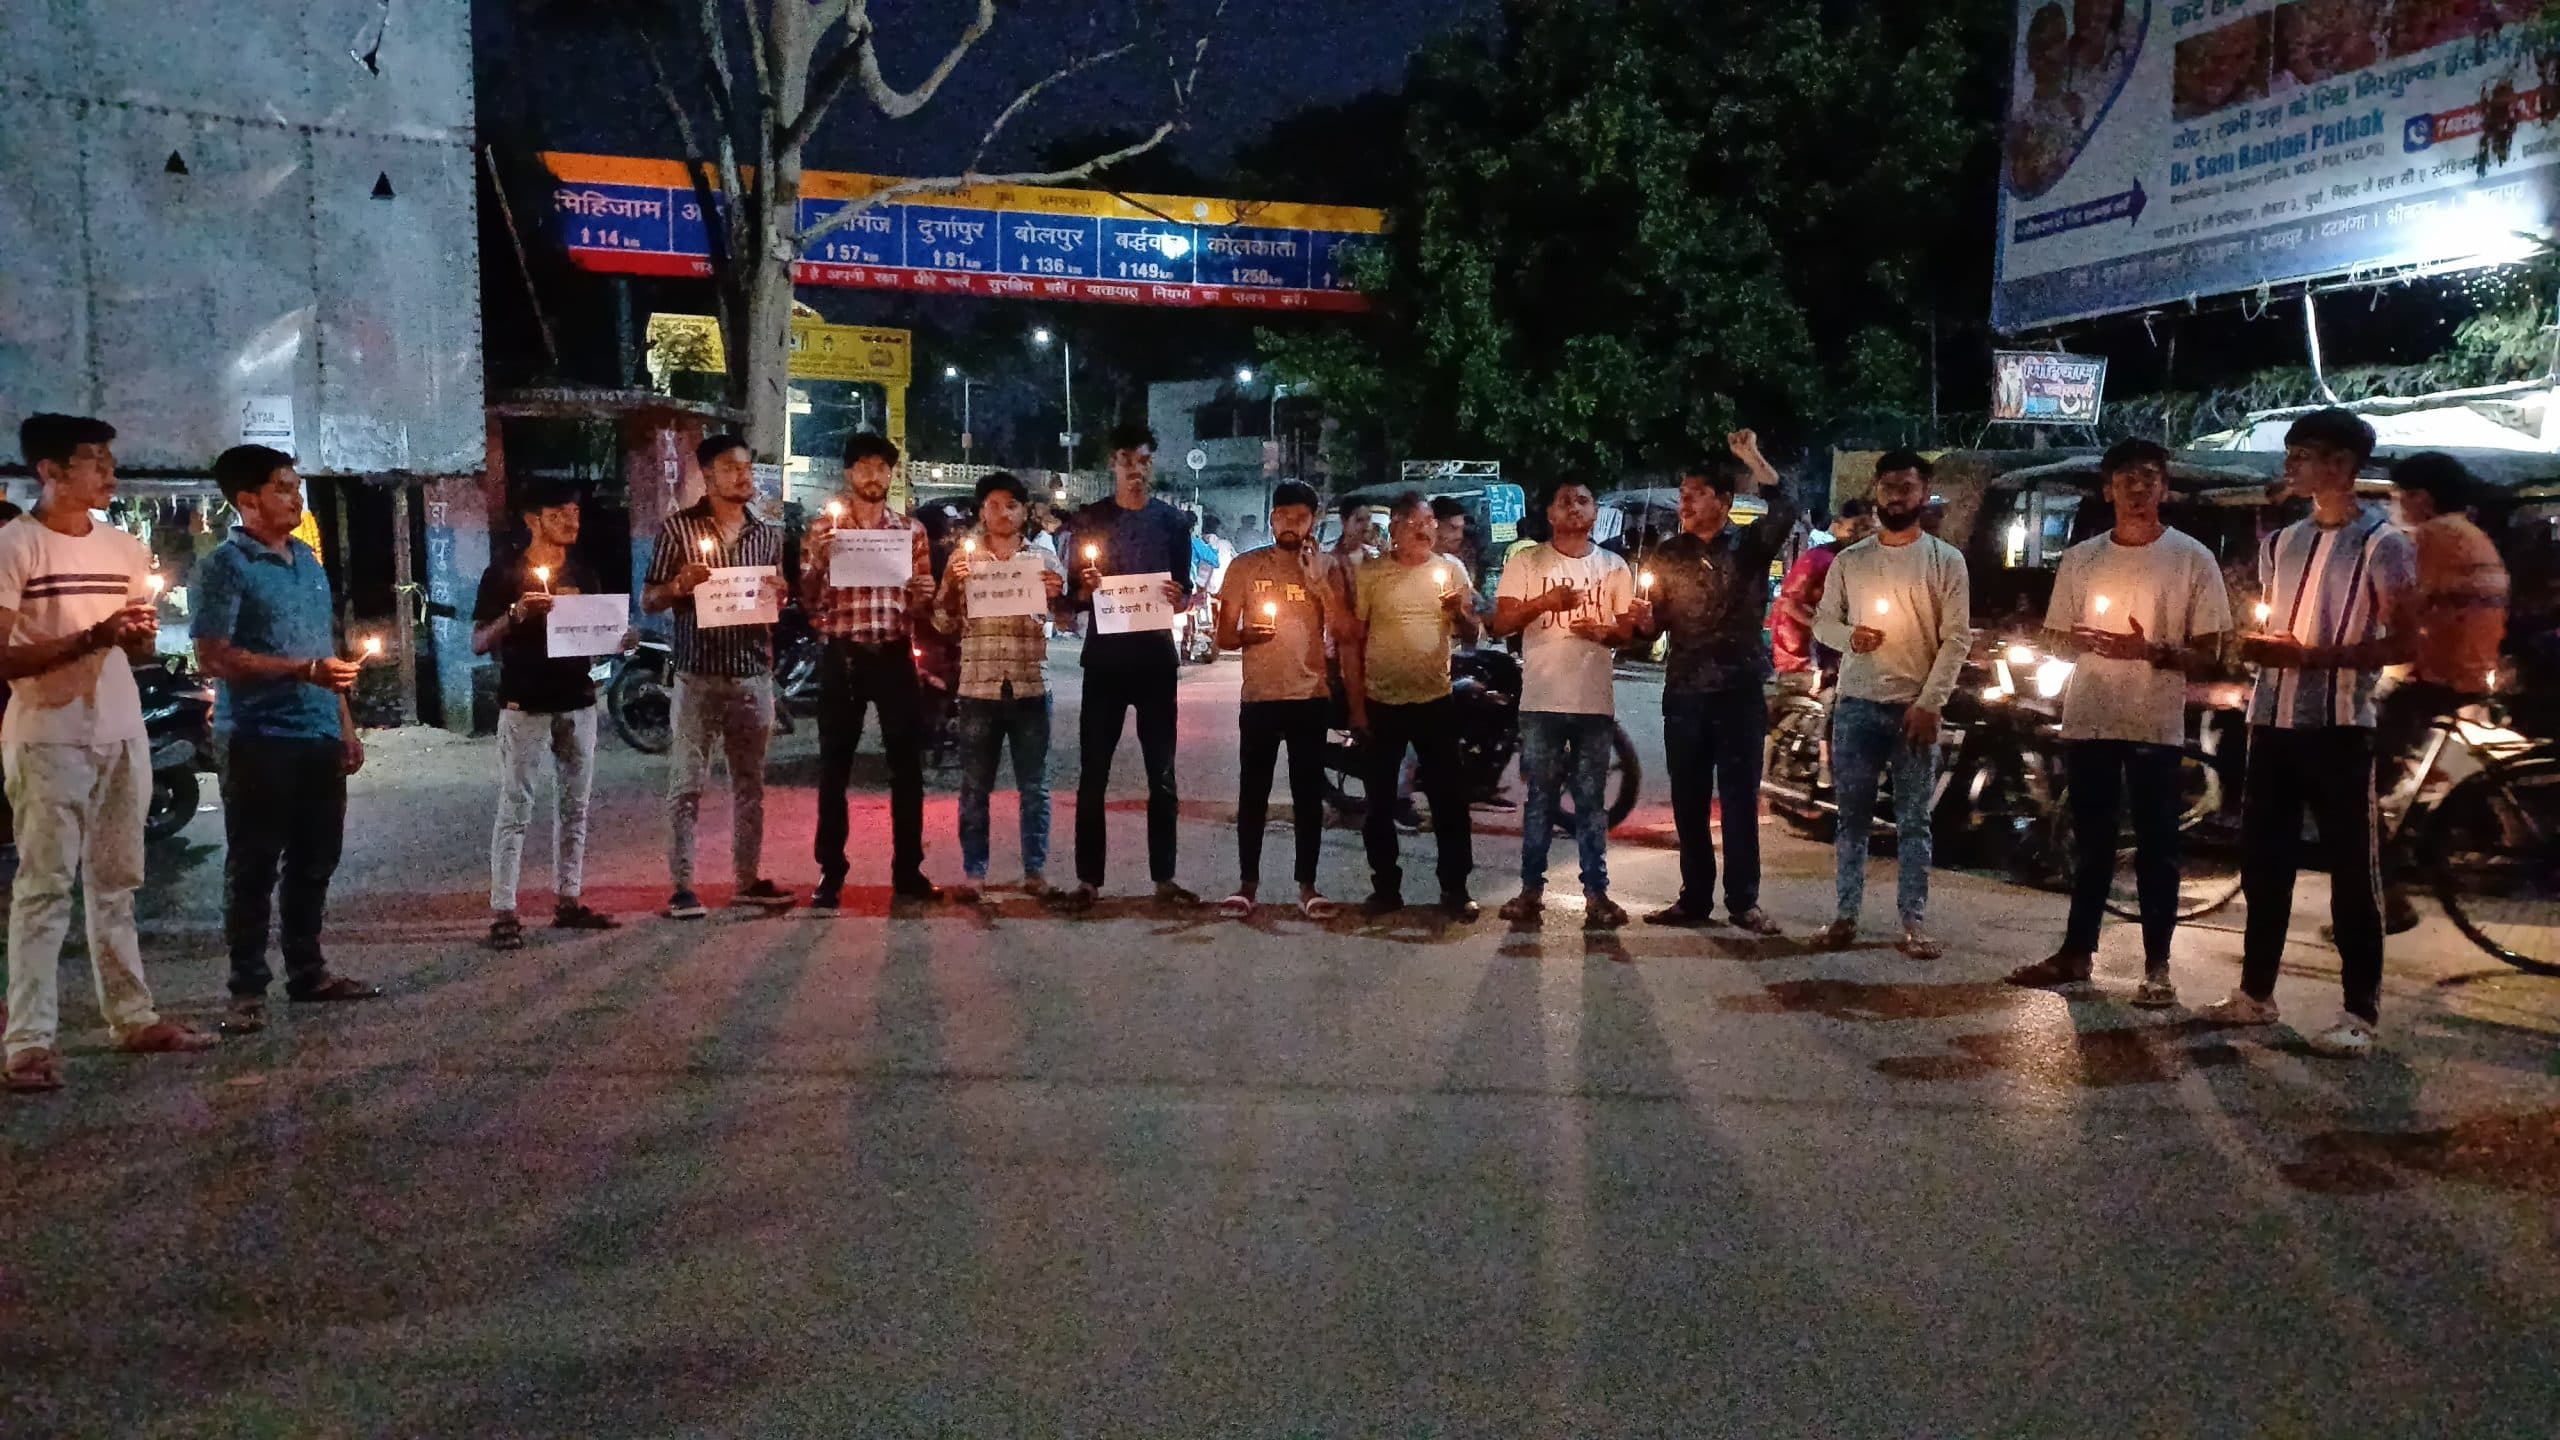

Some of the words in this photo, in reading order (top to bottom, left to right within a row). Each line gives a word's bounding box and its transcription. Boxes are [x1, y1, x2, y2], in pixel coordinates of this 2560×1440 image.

[2170, 161, 2191, 187] Dr.
[2312, 106, 2385, 150] Pathak
[597, 230, 619, 246] 14
[917, 215, 985, 246] दुर्गापुर
[1012, 220, 1085, 252] बोलपुर
[840, 245, 861, 261] 57
[1207, 233, 1298, 258] कोलकाता
[945, 252, 965, 268] 81
[1036, 256, 1065, 273] 136
[1129, 261, 1158, 280] 149
